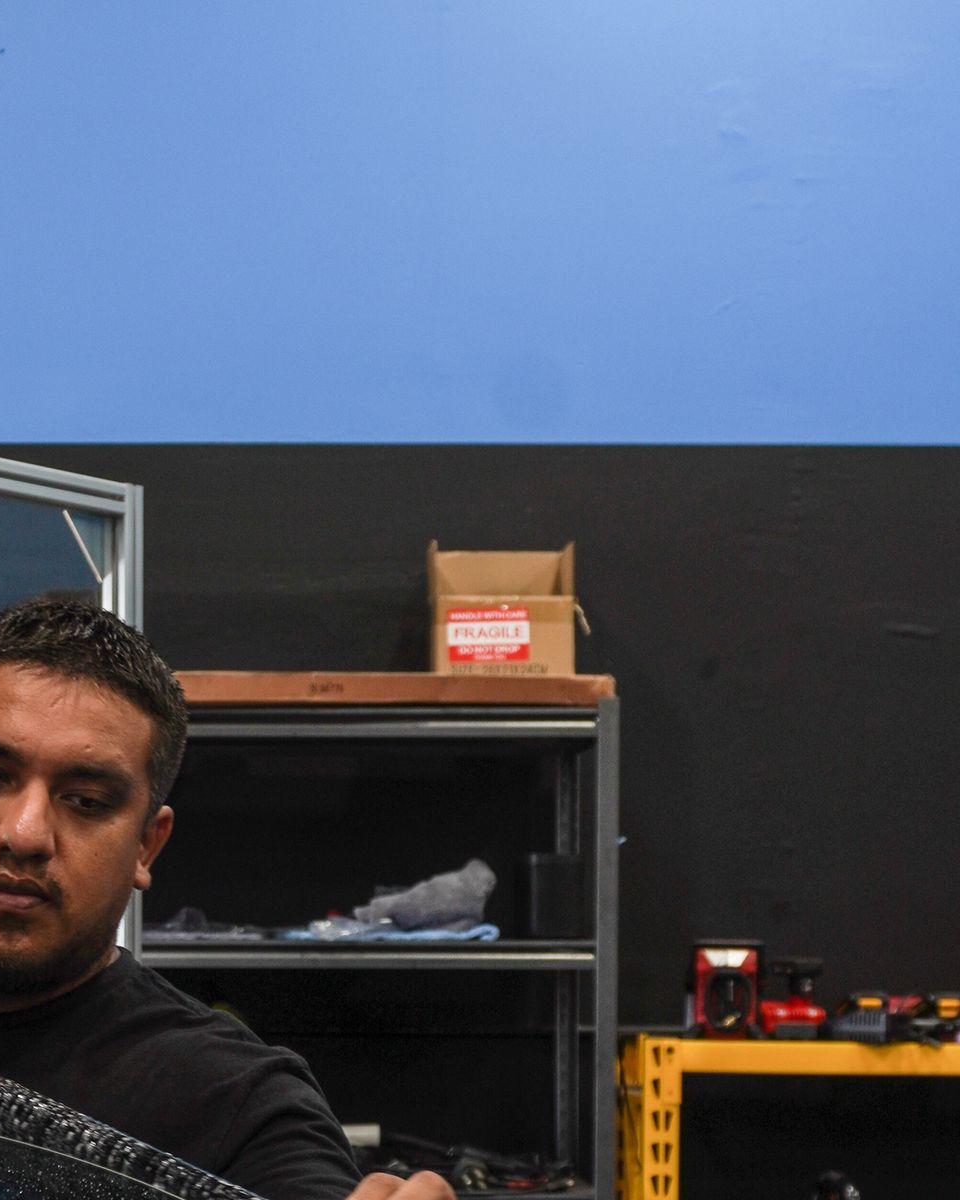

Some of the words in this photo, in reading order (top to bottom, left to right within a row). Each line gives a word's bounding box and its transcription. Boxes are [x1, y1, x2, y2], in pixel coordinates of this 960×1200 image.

[454, 625, 523, 640] FRAGILE
[458, 646, 474, 655] DO
[475, 645, 493, 654] NOT
[495, 644, 520, 653] DROP
